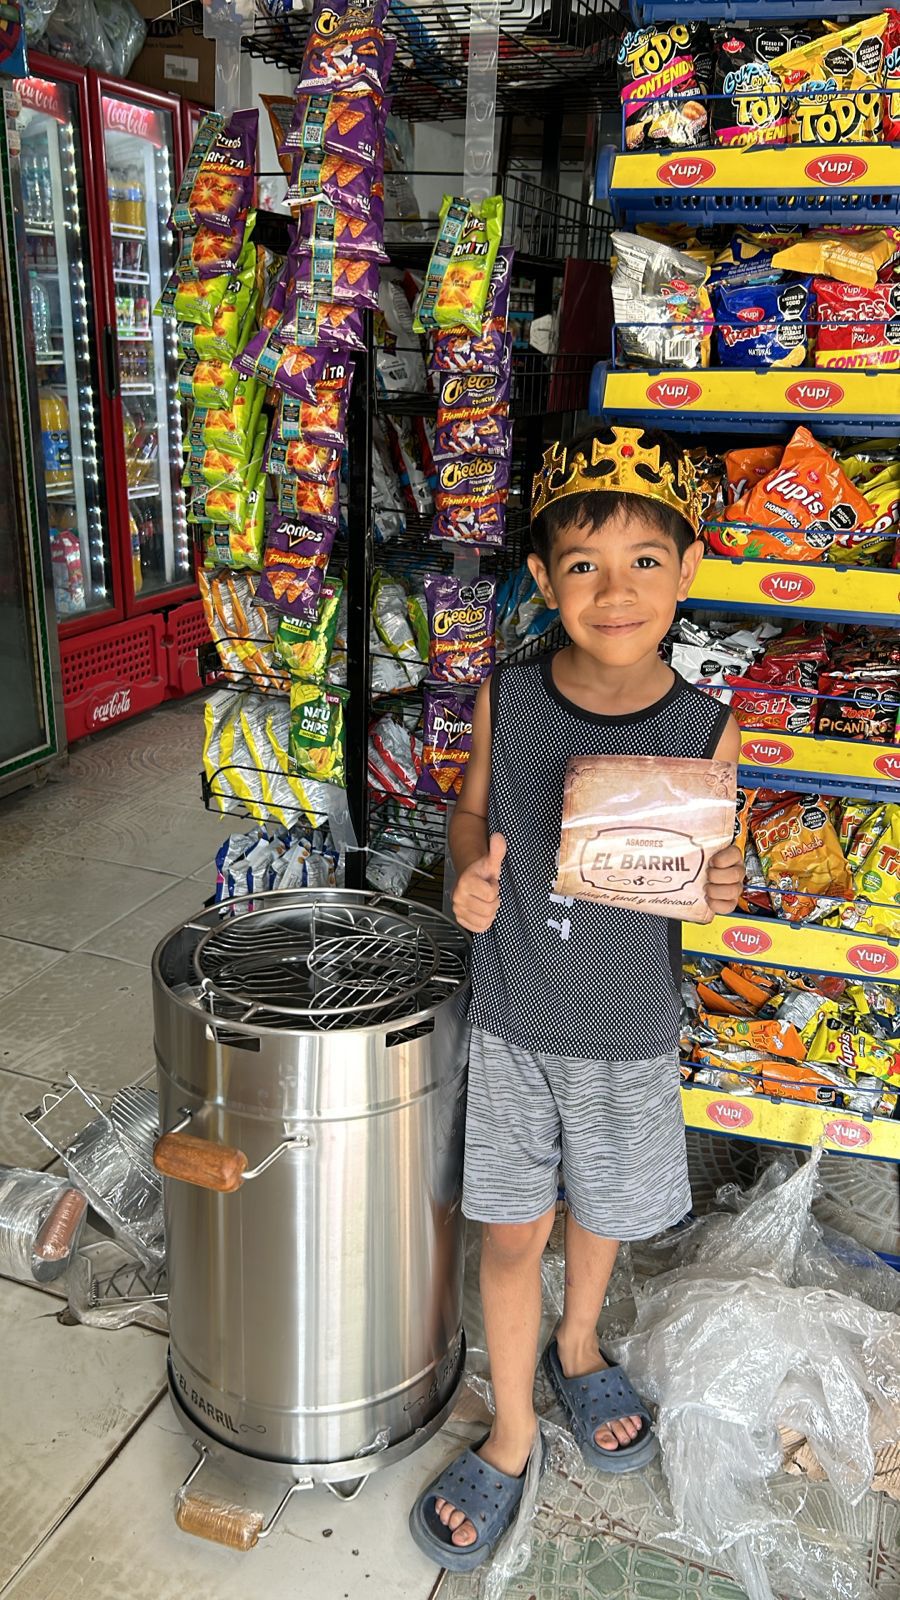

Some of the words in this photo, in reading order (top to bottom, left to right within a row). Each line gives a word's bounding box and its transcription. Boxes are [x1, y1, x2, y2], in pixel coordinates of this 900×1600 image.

[730, 125, 787, 145] CONTEN
[669, 162, 702, 178] Yupi
[818, 160, 852, 175] Yupi
[827, 353, 900, 368] CONTENID
[658, 383, 689, 398] Yupi
[797, 385, 830, 400] Yupi
[443, 458, 495, 488] Cheetos
[766, 470, 824, 515] Yupis
[764, 502, 801, 529] HORNEADOS
[277, 523, 323, 543] Doritos
[771, 578, 802, 593] Yupi
[434, 606, 485, 636] Cheetos
[303, 706, 330, 721] NATU
[840, 706, 876, 719] Tosti
[301, 719, 329, 736] CHIPS
[433, 716, 473, 734] Dorito
[752, 743, 781, 757] Yupi
[885, 759, 900, 770] Yu
[625, 838, 664, 849] ASADORES
[591, 853, 613, 872] EL
[620, 854, 690, 872] BARRIL
[732, 931, 761, 946] Yupi
[857, 950, 886, 965] Yupi
[716, 1106, 742, 1120] Yupi
[833, 1125, 860, 1140] Yupi
[179, 1373, 189, 1395] EL
[191, 1389, 239, 1434] BARRIL
